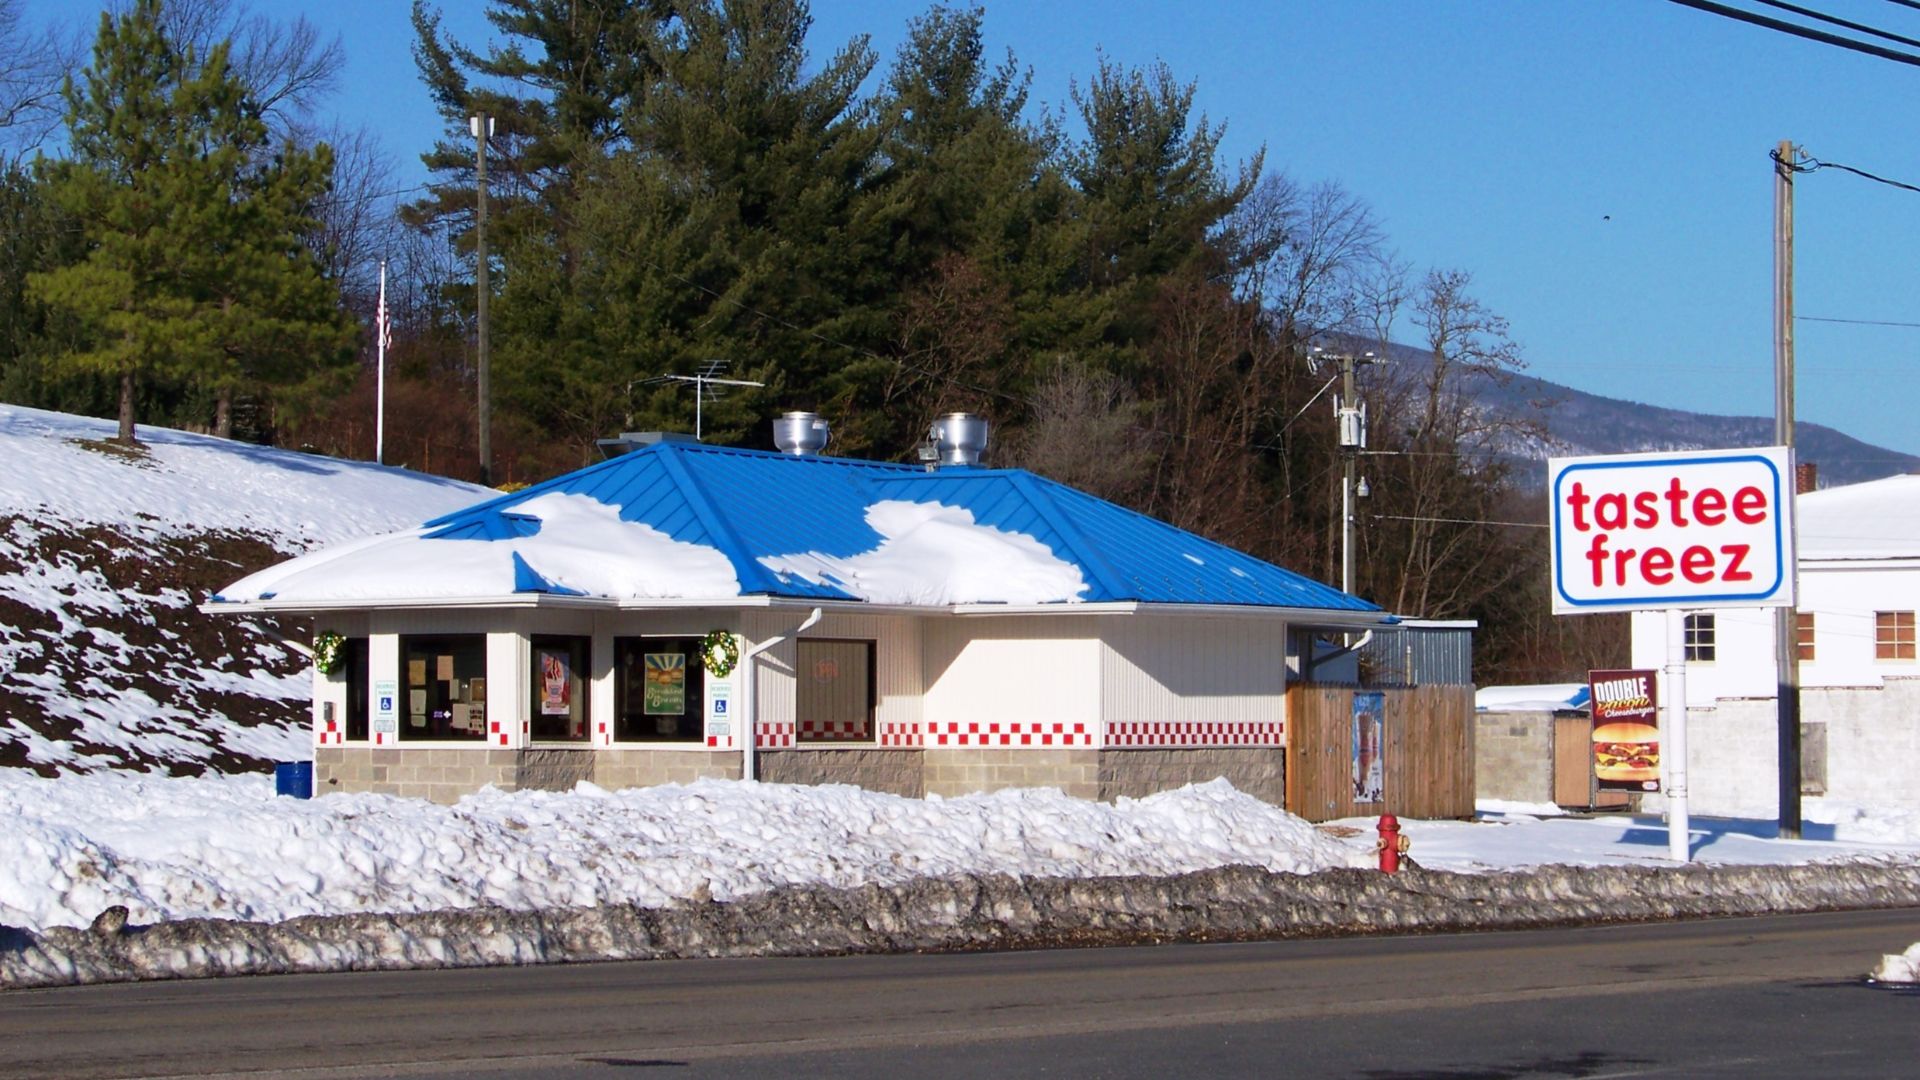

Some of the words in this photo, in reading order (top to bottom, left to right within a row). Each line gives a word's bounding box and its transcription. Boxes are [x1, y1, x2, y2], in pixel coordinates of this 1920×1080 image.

[1567, 478, 1767, 531] tastee
[1586, 534, 1753, 587] freez
[1594, 678, 1648, 702] DOUBLE
